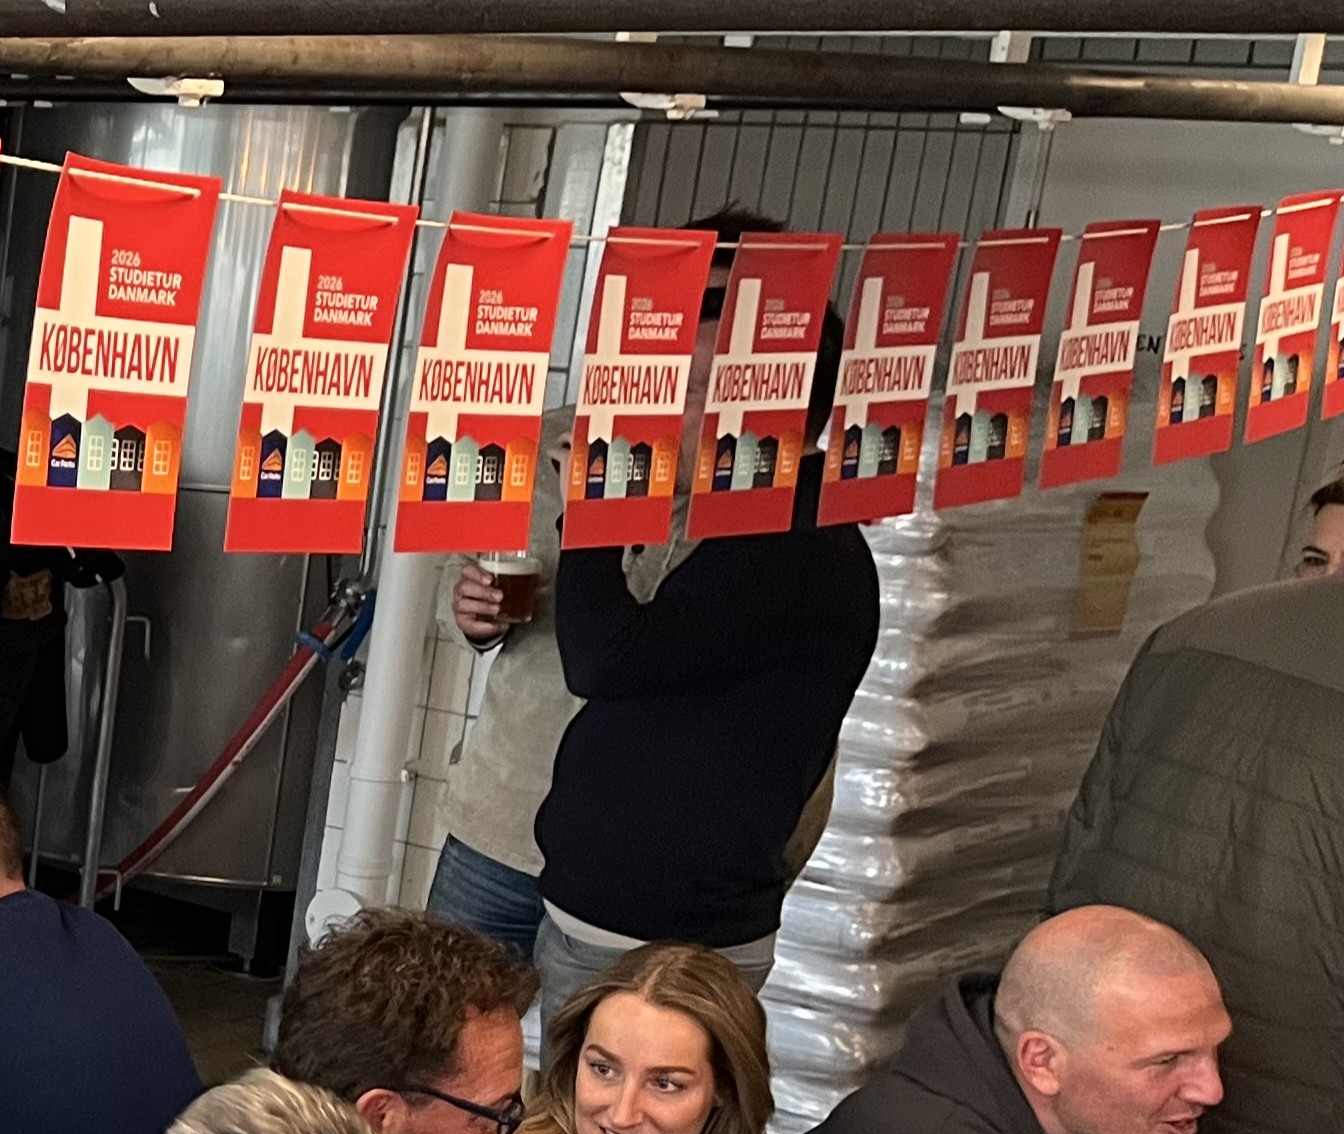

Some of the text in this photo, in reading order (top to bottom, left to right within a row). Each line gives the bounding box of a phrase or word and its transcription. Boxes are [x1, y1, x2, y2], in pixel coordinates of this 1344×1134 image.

[111, 249, 141, 267] 2026
[109, 267, 182, 290] STUDIETUR
[317, 275, 343, 291] 2026
[108, 284, 176, 306] DANMARK
[315, 291, 378, 311] STUDIETUR
[479, 289, 503, 304] 2026
[313, 308, 373, 327] DANMARK
[477, 304, 538, 322] STUDIETUR
[629, 312, 684, 327] STUDIETUR
[475, 320, 532, 337] DANMARK
[1169, 312, 1237, 352] KØBENHAVN
[39, 321, 180, 384] KØBENHAVN
[1060, 330, 1130, 371] KØBENHAVN
[253, 346, 374, 398] KØBENHAVN
[840, 355, 926, 396] KØBENHAVN
[951, 344, 1032, 386] KØBENHAVN
[419, 358, 535, 405] KØBENHAVN
[583, 363, 679, 406] KØBENHAVN
[712, 362, 806, 403] KØBENHAVN
